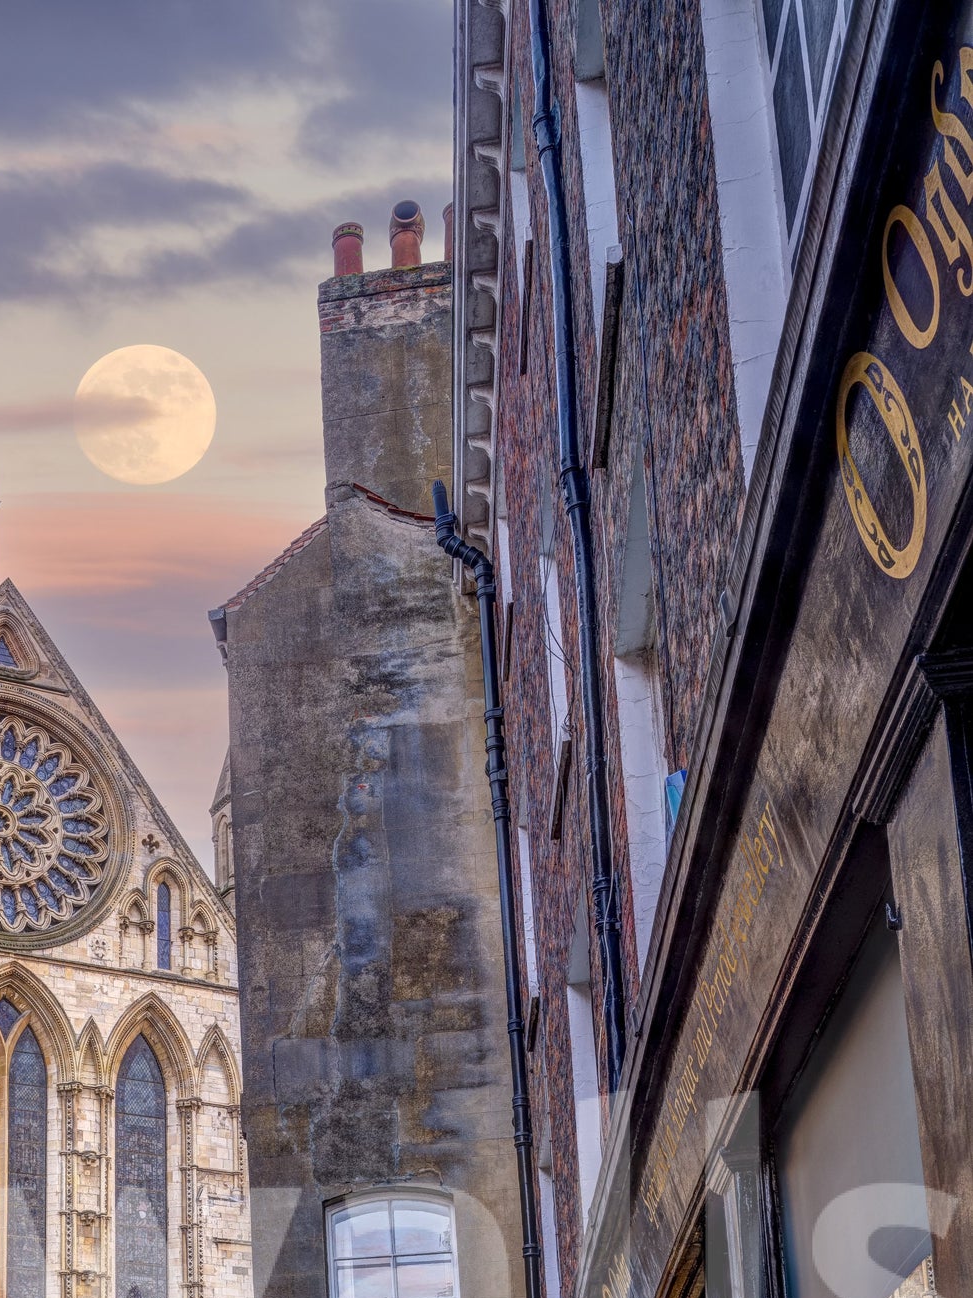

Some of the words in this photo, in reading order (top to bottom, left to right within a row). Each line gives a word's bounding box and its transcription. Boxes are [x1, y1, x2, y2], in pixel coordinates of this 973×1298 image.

[700, 920, 738, 1030] Period
[692, 995, 713, 1070] and
[666, 1054, 700, 1142] Antique
